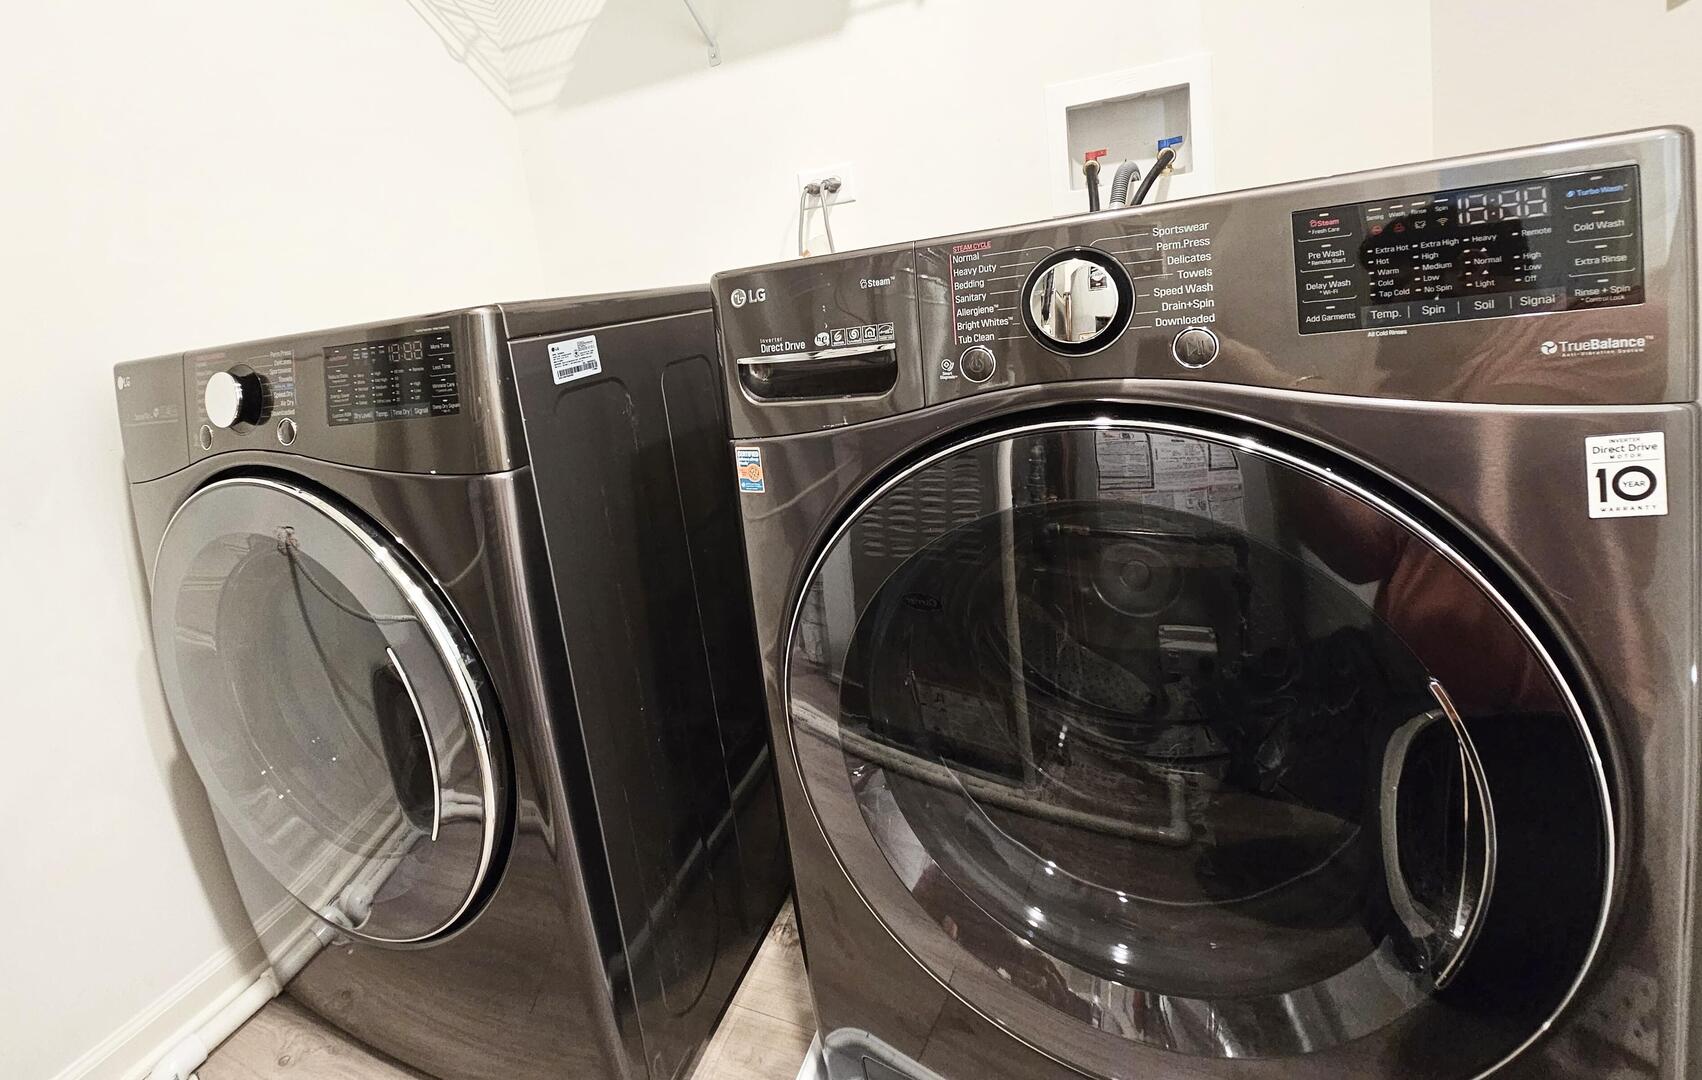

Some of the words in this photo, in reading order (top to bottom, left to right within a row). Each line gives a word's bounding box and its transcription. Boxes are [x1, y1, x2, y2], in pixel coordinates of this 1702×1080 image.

[1317, 218, 1340, 227] Steam
[1573, 223, 1595, 232] Cold
[1595, 219, 1625, 230] Wash
[1152, 222, 1210, 237] Sportswear
[1521, 226, 1552, 236] Remote
[1420, 240, 1441, 248] Extra
[1441, 238, 1459, 247] High
[1472, 234, 1497, 243] Heavy
[953, 244, 973, 252] STEAM
[973, 241, 992, 250] CYCLE
[1375, 245, 1395, 254] Extra
[1396, 243, 1409, 251] Hot
[952, 253, 980, 264] Normal
[1166, 252, 1212, 265] Delicates
[1322, 249, 1345, 258] Wash
[1421, 252, 1439, 260] High
[1522, 251, 1542, 261] High
[1473, 256, 1502, 265] Normal
[1574, 257, 1600, 265] Extra
[1601, 254, 1628, 264] Rinse
[953, 266, 977, 278] Heavy
[978, 263, 997, 274] Duty
[1377, 268, 1400, 276] Warm
[1422, 262, 1452, 271] Medium
[1524, 263, 1542, 271] Low
[1176, 267, 1213, 279] Towels
[954, 278, 984, 291] Bedding
[1377, 279, 1394, 287] Cold
[1475, 279, 1495, 289] Light
[1524, 275, 1537, 283] Off
[1153, 285, 1184, 298] Speed
[1185, 282, 1214, 295] Wash
[1306, 282, 1328, 291] Delay
[1328, 279, 1351, 288] Wash
[1436, 284, 1453, 293] Spin
[1574, 288, 1600, 296] Rinse
[1610, 284, 1631, 295] Spin
[749, 288, 766, 303] LG
[955, 292, 987, 304] Sanitary
[1378, 290, 1393, 299] Tap
[1393, 288, 1410, 296] Cold
[1161, 299, 1215, 312] Drain+Spin
[1474, 300, 1495, 310] Soil
[1519, 294, 1556, 307] Signal
[1370, 310, 1402, 320] Temp.
[1422, 305, 1446, 316] Spin
[1155, 314, 1216, 327] Downloaded
[1306, 315, 1321, 323] Add
[1321, 312, 1356, 322] Garments
[957, 318, 980, 332] Bright
[958, 334, 975, 344] Tub
[975, 332, 995, 343] Clean
[760, 342, 784, 353] Direct
[785, 341, 806, 352] Drive
[1592, 445, 1625, 454] Direct
[1628, 443, 1658, 452] Drive
[1595, 465, 1657, 503] 10
[1601, 504, 1657, 512] WARRANTY
